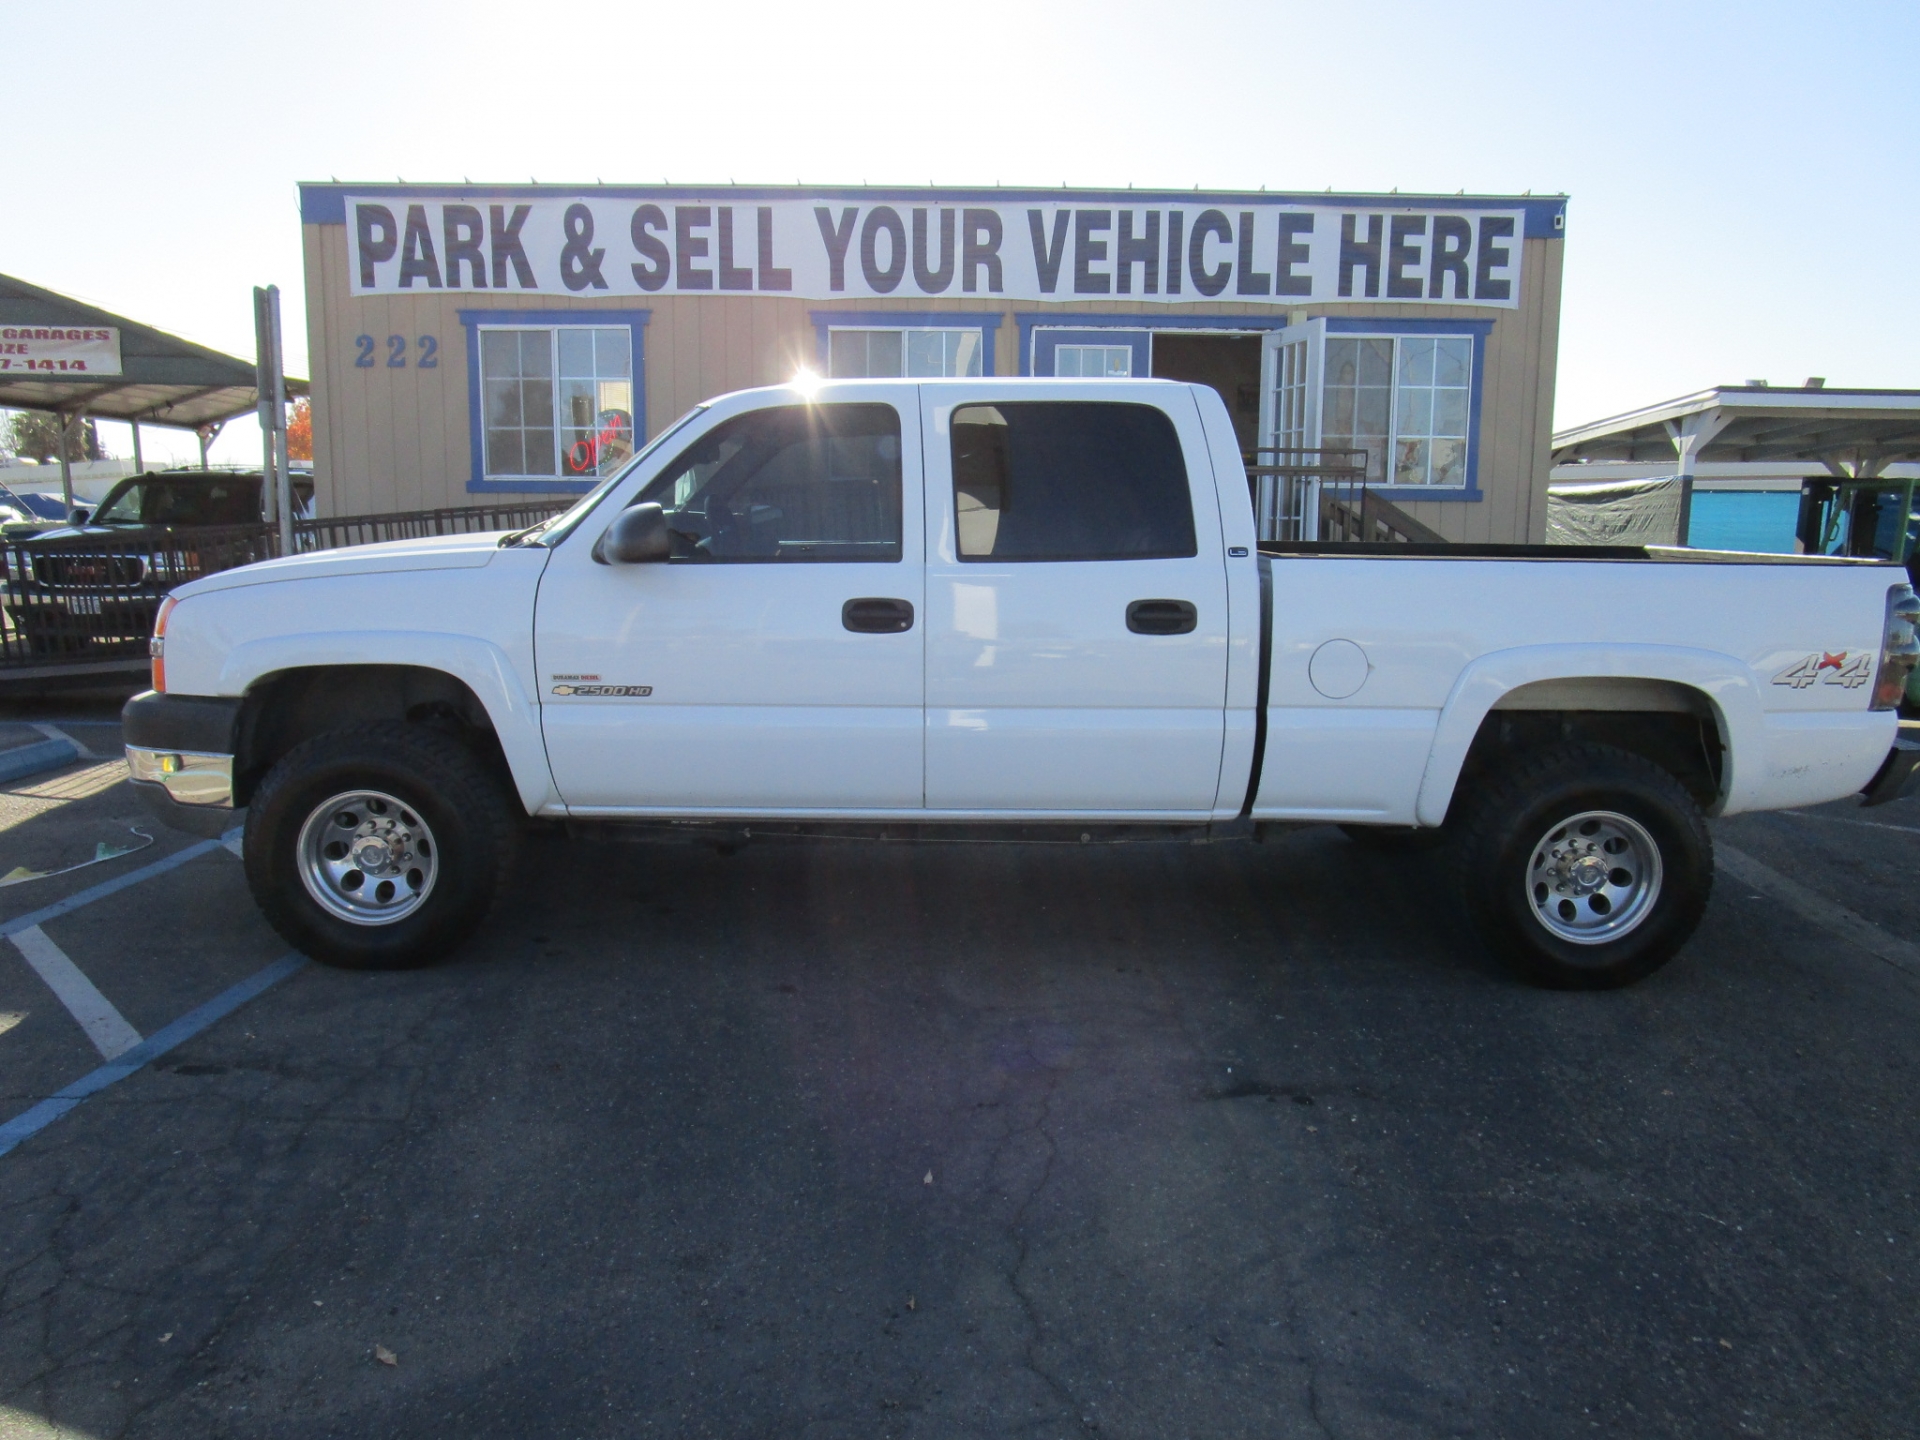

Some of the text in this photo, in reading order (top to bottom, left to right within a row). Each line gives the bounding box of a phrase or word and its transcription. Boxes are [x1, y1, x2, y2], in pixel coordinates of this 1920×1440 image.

[355, 203, 1516, 301] PARK & SELL YOUR VEHICLE HERE
[2, 328, 110, 341] GARAGES
[355, 334, 438, 368] 222
